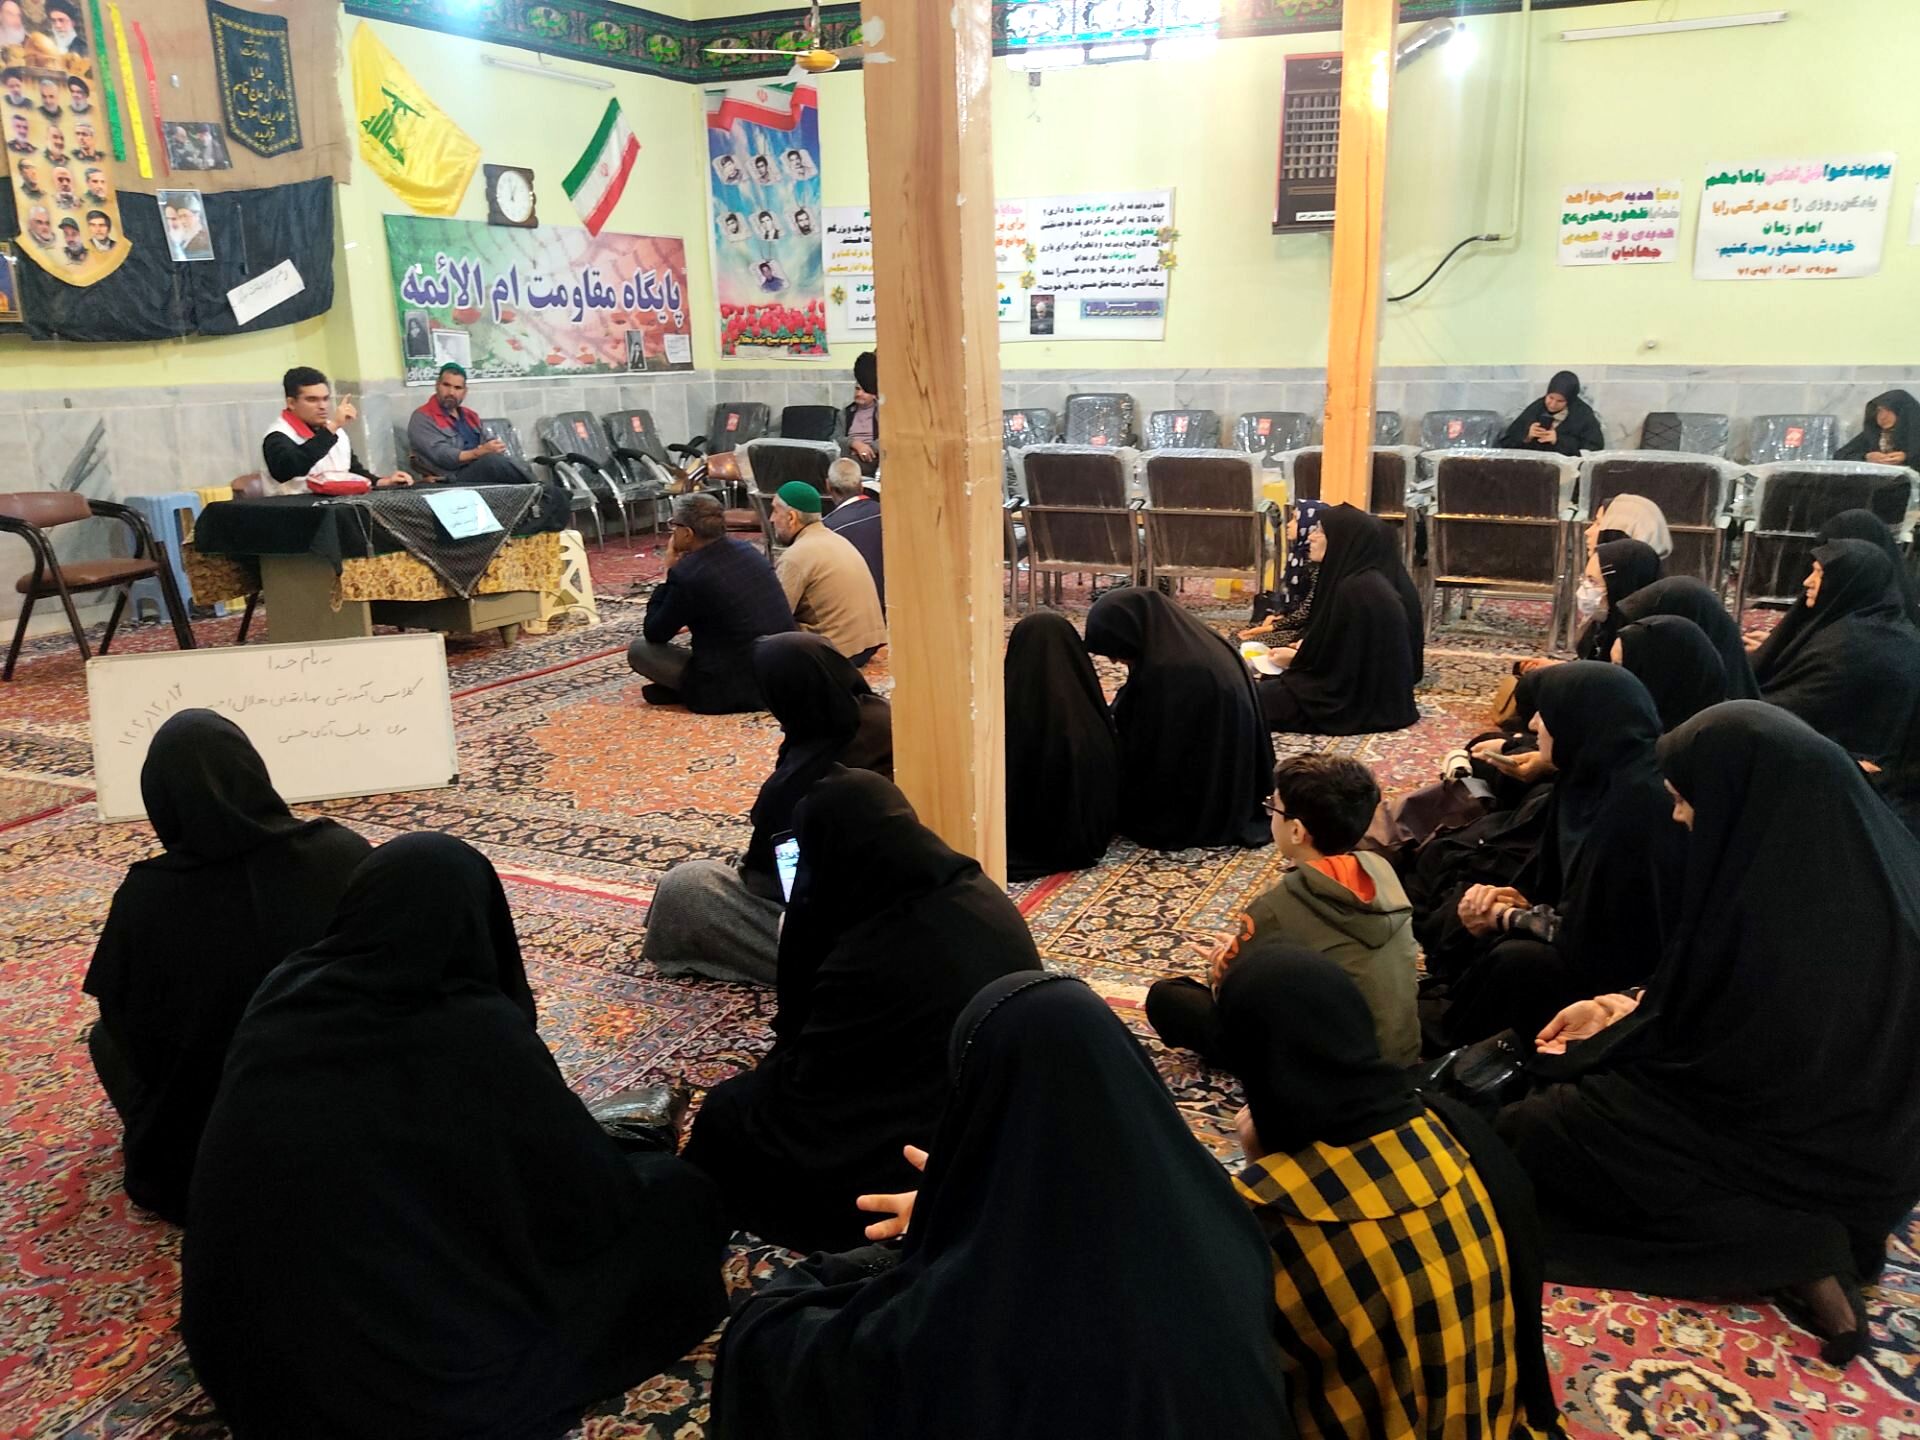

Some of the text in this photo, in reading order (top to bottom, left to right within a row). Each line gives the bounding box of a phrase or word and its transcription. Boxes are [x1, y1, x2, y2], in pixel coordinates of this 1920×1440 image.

[1624, 190, 1654, 204] هدیه
[1611, 207, 1648, 223] ظهور
[1762, 221, 1823, 236] امام زمان
[1611, 245, 1662, 261] جهانیان
[491, 264, 521, 323] ام
[526, 266, 618, 324] مقاومت
[623, 268, 685, 328] پایگاه
[267, 654, 298, 670] خدا
[300, 649, 321, 672] نام
[371, 677, 424, 704] کلاس
